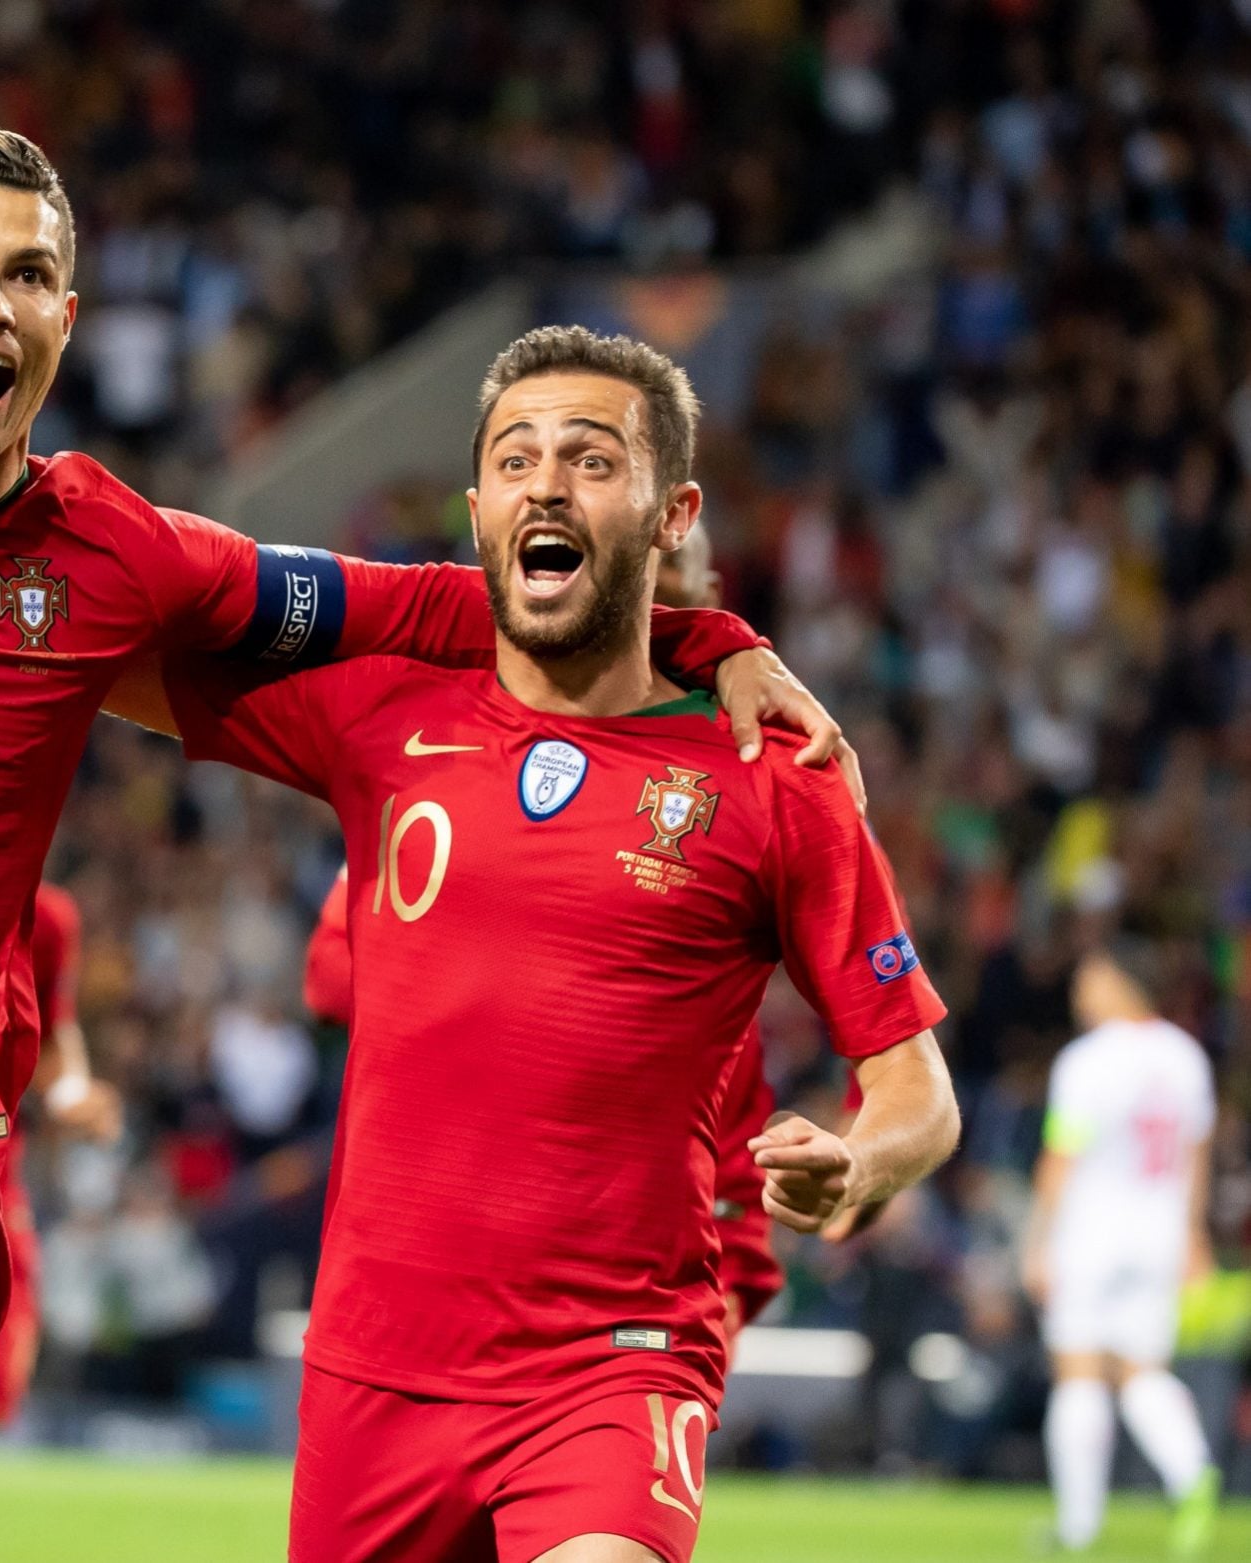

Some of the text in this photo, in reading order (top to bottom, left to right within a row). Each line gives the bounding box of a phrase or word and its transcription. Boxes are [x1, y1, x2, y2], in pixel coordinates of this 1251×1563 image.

[277, 573, 312, 652] RESPECT
[531, 761, 577, 778] CHAMPIONS
[534, 754, 580, 771] EUROPEAN
[372, 793, 452, 922] 10
[615, 851, 663, 870] PORTUGAL
[624, 864, 632, 873] 5
[635, 878, 669, 895] PORTO
[646, 1393, 707, 1507] 10
